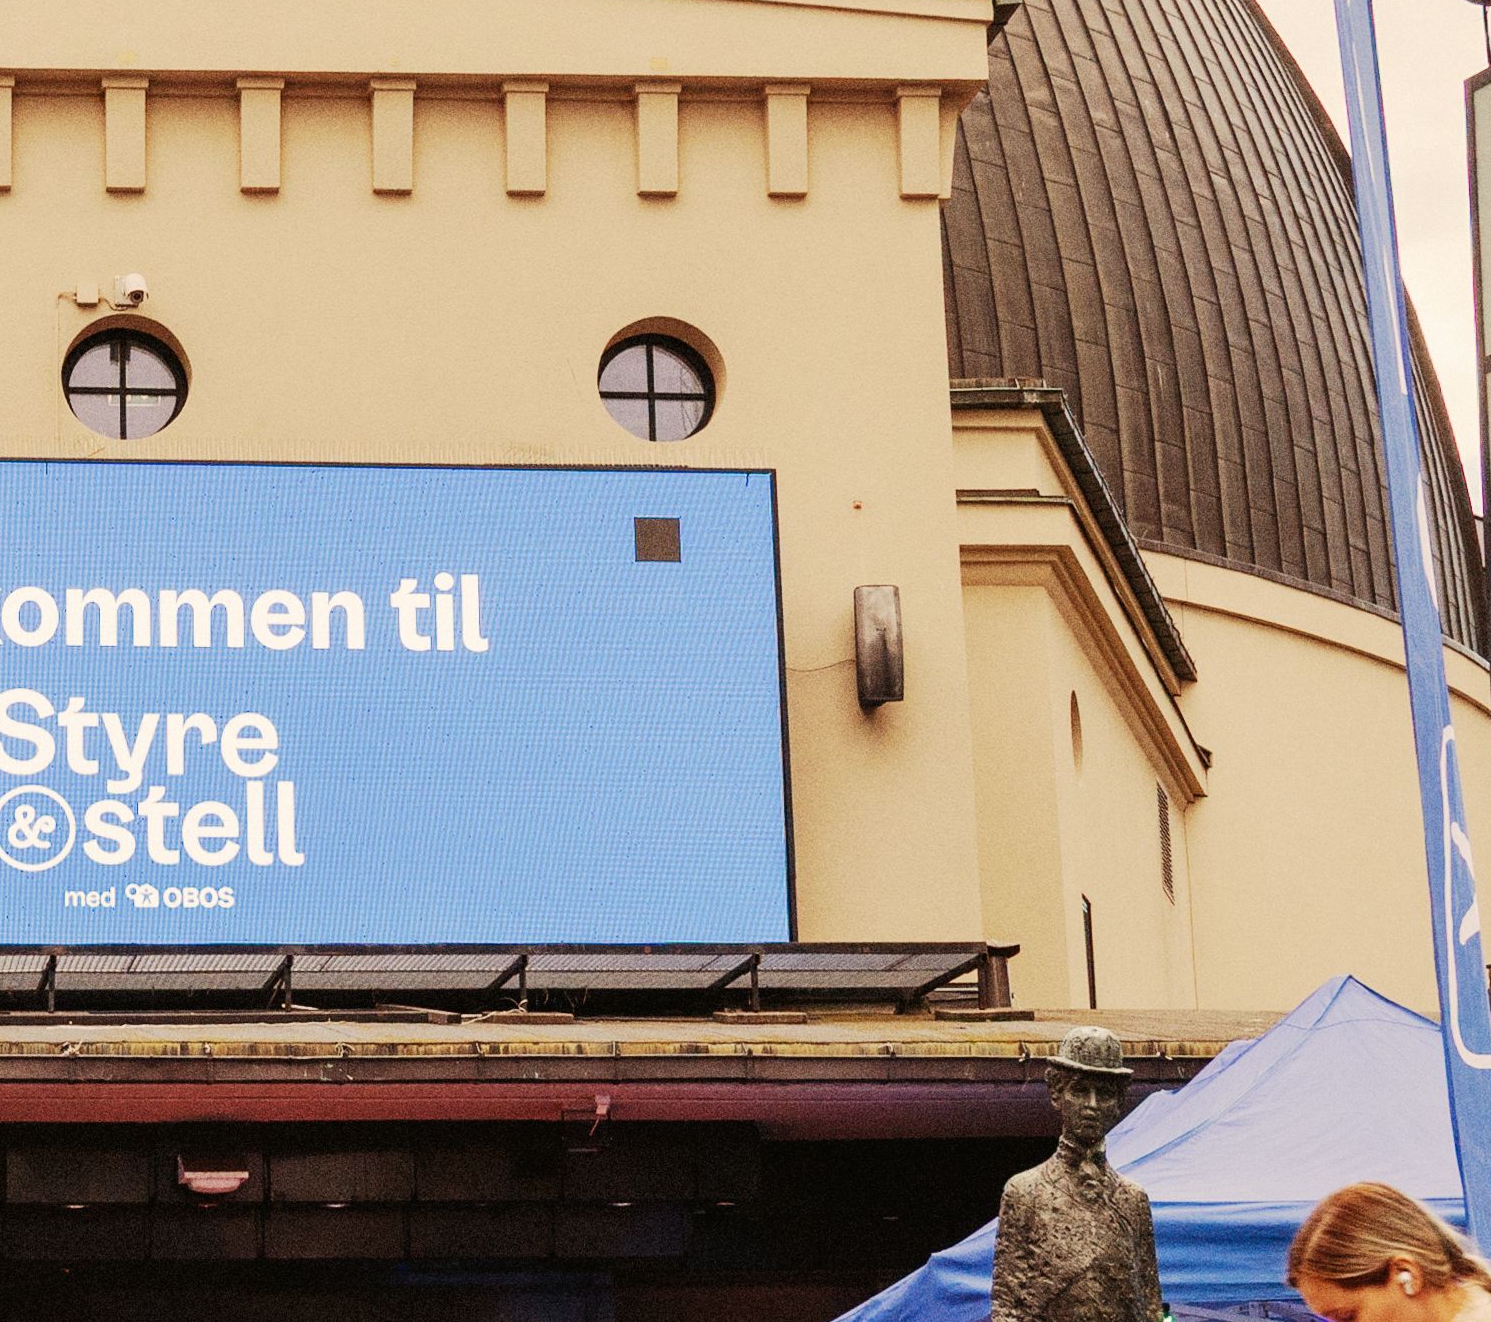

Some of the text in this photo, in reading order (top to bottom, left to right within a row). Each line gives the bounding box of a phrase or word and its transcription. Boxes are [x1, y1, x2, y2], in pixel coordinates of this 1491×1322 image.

[391, 572, 489, 654] til
[83, 781, 305, 869] stell
[64, 886, 235, 909] med OBOS
